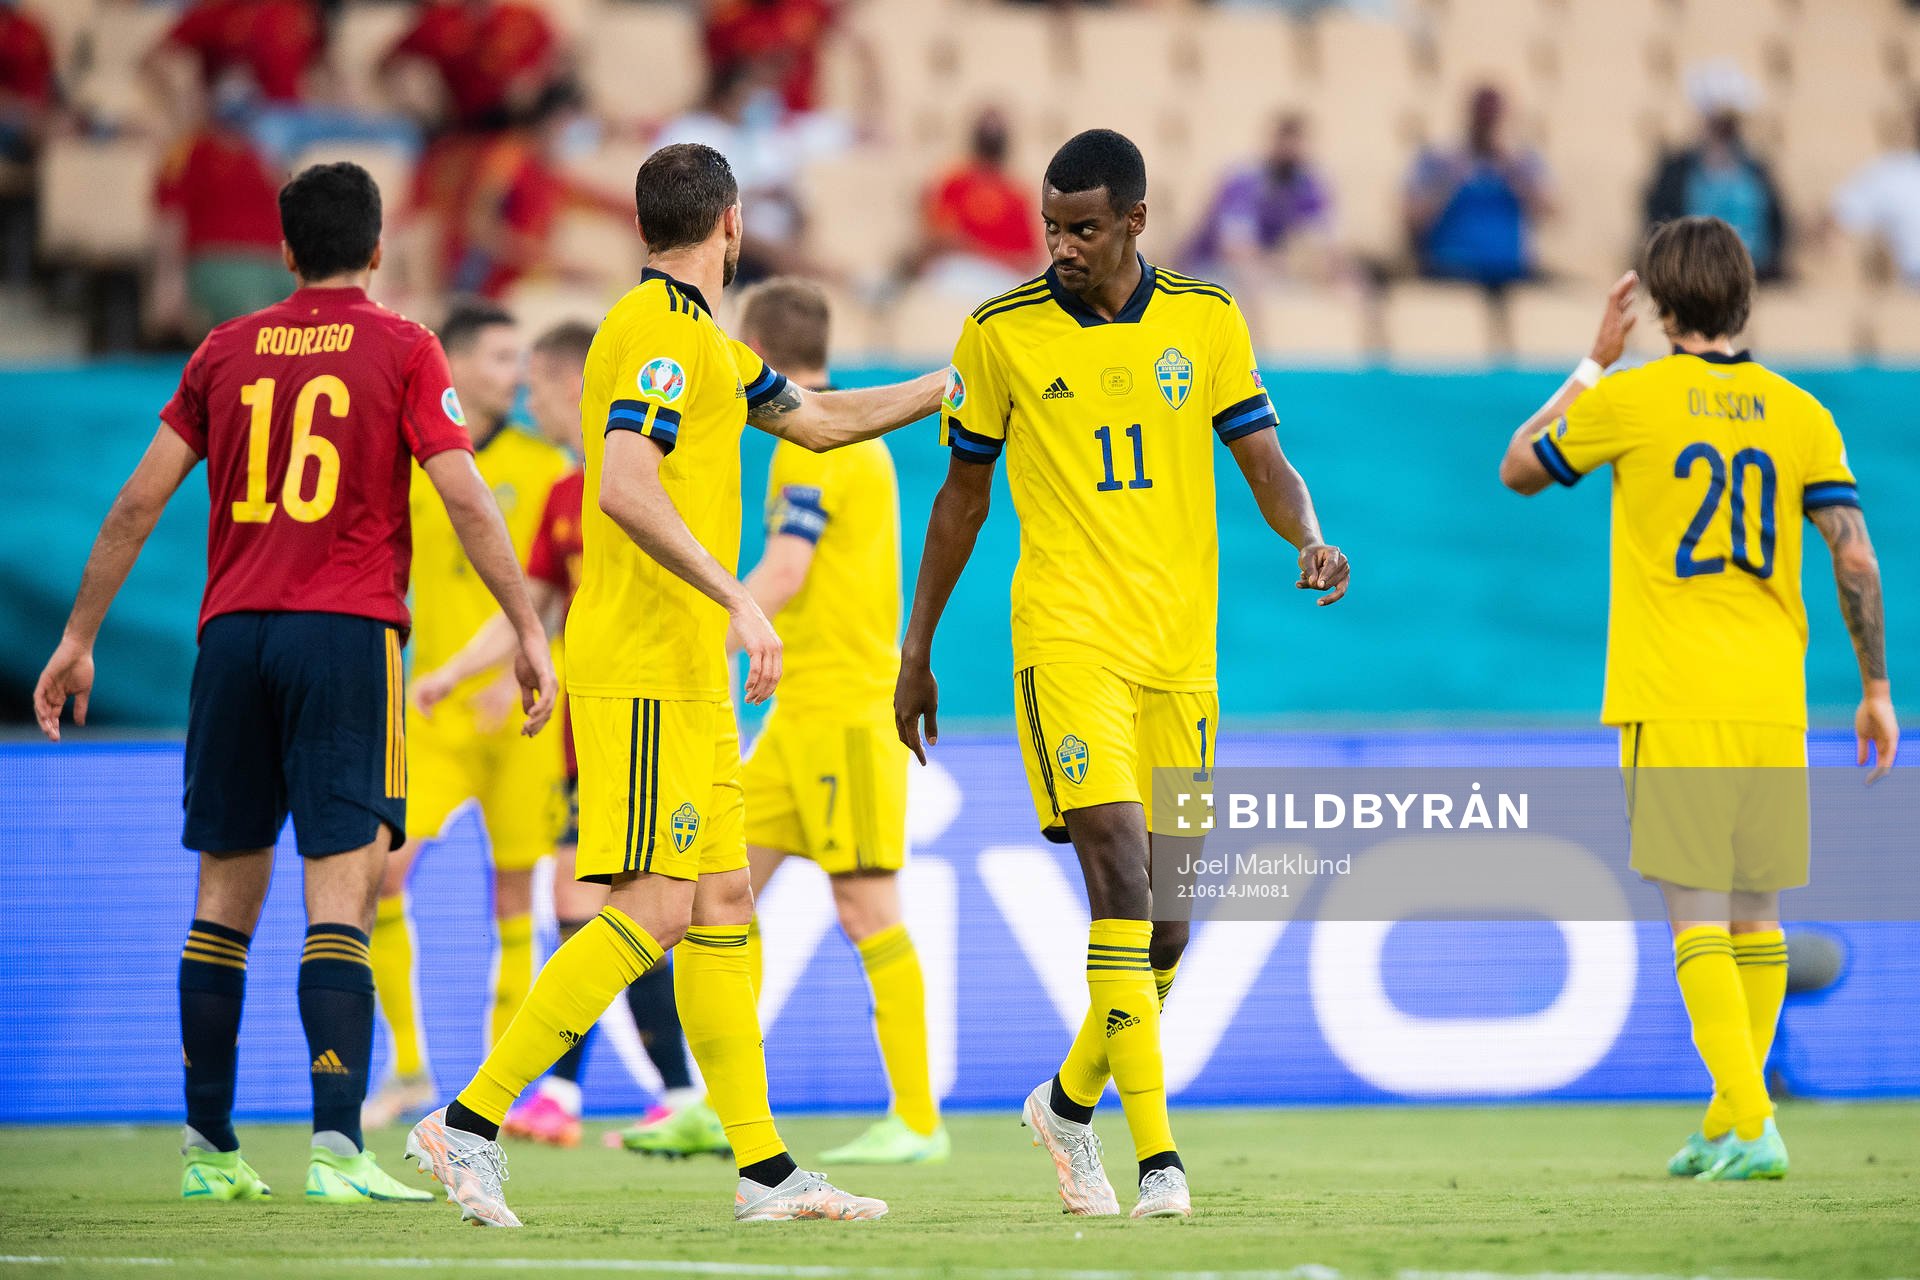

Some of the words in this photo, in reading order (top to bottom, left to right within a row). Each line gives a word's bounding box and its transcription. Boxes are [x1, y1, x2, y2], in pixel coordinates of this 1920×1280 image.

[255, 324, 354, 356] RODRIGO
[1041, 390, 1075, 401] adidas
[1688, 387, 1766, 421] OLSSON
[231, 374, 351, 524] 16
[1094, 423, 1153, 492] 11
[1674, 441, 1777, 579] 20
[820, 776, 837, 828] 7
[1106, 1016, 1141, 1039] adidas
